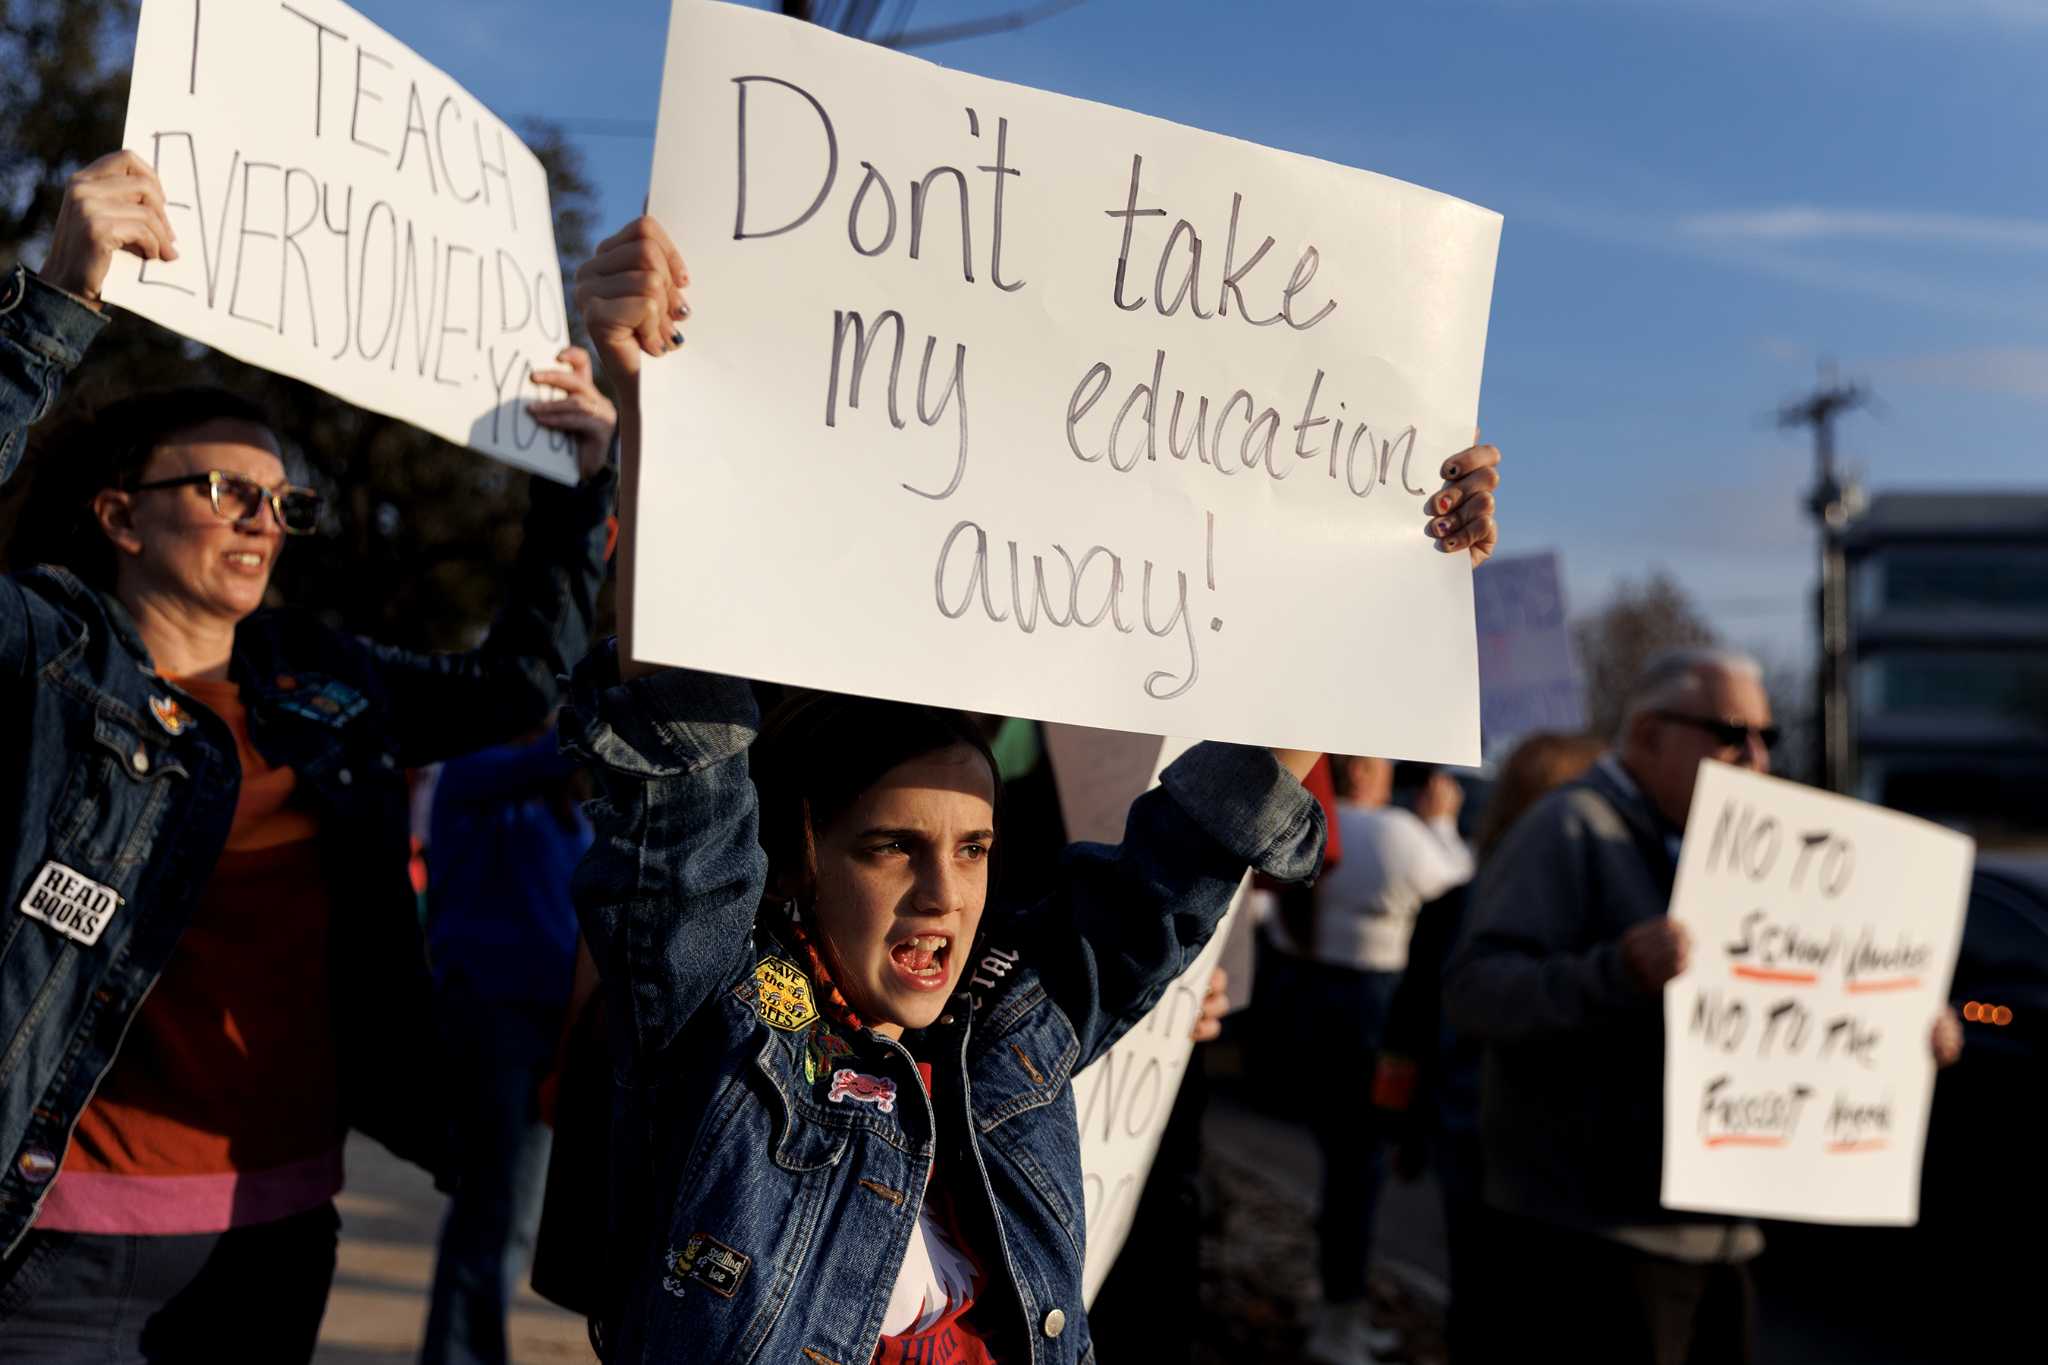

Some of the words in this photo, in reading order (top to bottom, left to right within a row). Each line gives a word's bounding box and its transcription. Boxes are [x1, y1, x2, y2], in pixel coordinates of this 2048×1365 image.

[281, 3, 518, 232] TEACH
[732, 75, 1027, 291] Don't
[1104, 153, 1337, 330] take
[1066, 349, 1425, 498] education
[934, 511, 1224, 700] away!
[1703, 798, 1784, 883] NO
[1787, 828, 1857, 900] TO
[30, 888, 100, 936] BOOKS
[44, 868, 110, 914] READ
[764, 971, 785, 991] the
[767, 960, 801, 986] SAVE
[760, 1000, 793, 1027] BEES
[1691, 986, 1750, 1055] NO
[1757, 998, 1815, 1061] TO
[707, 1247, 745, 1277] spelling
[708, 1265, 726, 1283] bee
